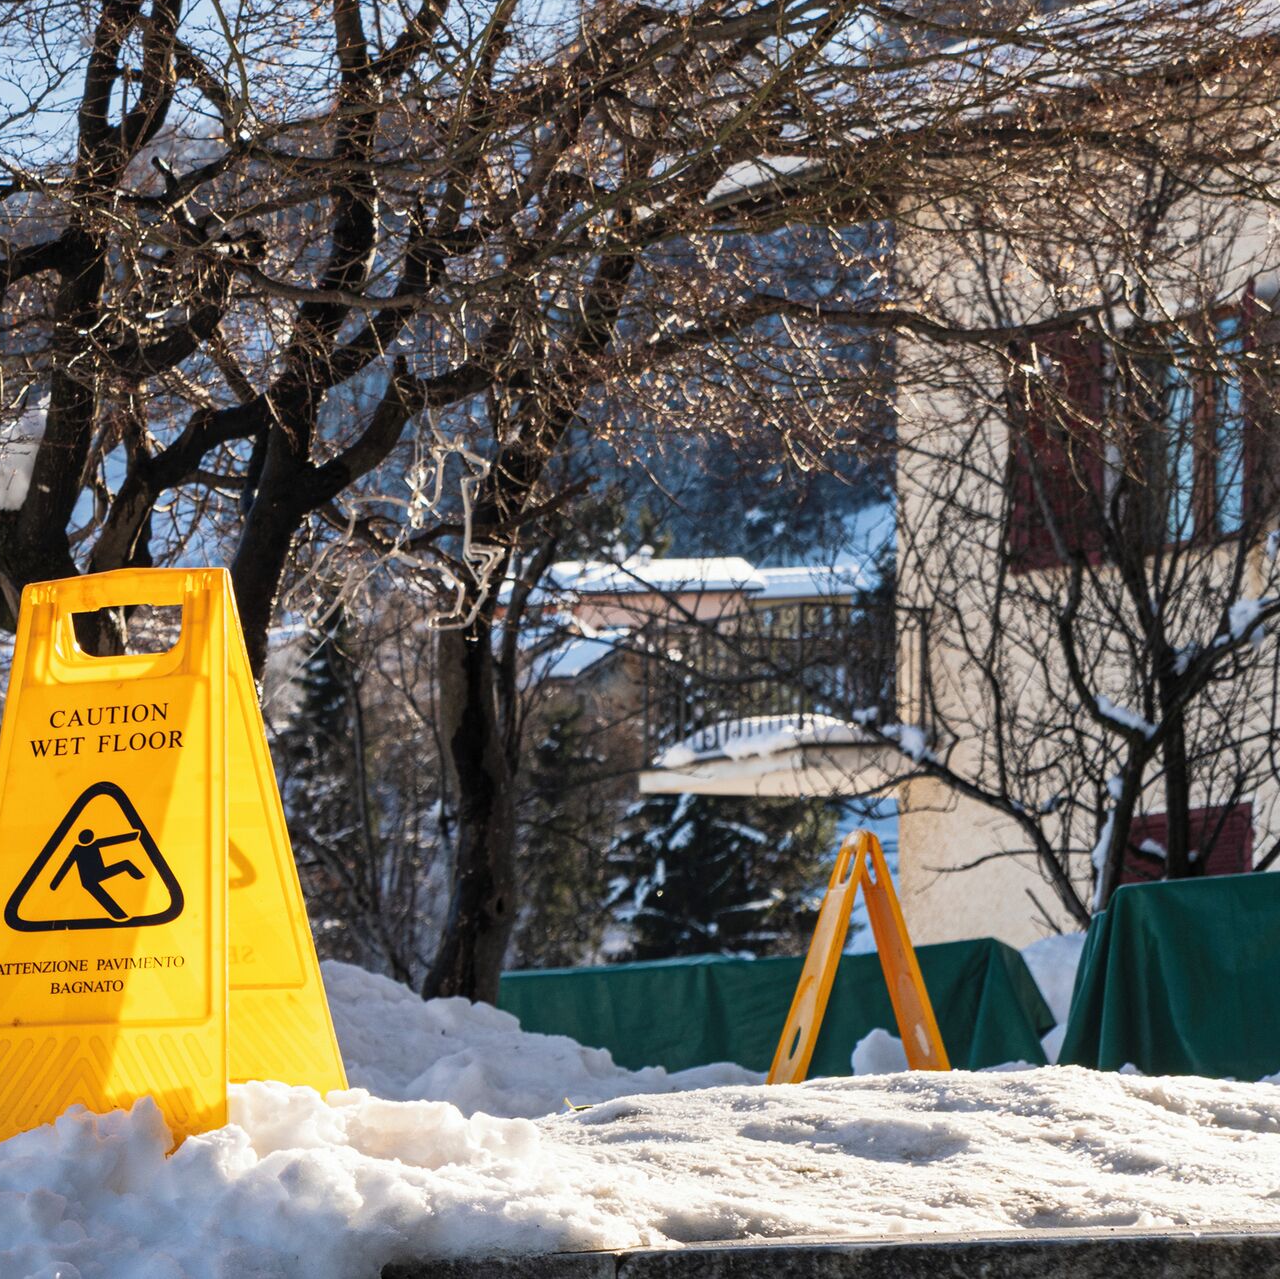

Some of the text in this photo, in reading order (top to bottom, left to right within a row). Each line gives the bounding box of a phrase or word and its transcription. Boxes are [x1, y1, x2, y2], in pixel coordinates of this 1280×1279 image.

[50, 703, 168, 728] CAUTION
[30, 730, 183, 757] WET FLOOR
[97, 956, 184, 971] PAVIMENTO
[51, 980, 123, 994] BAGNATO
